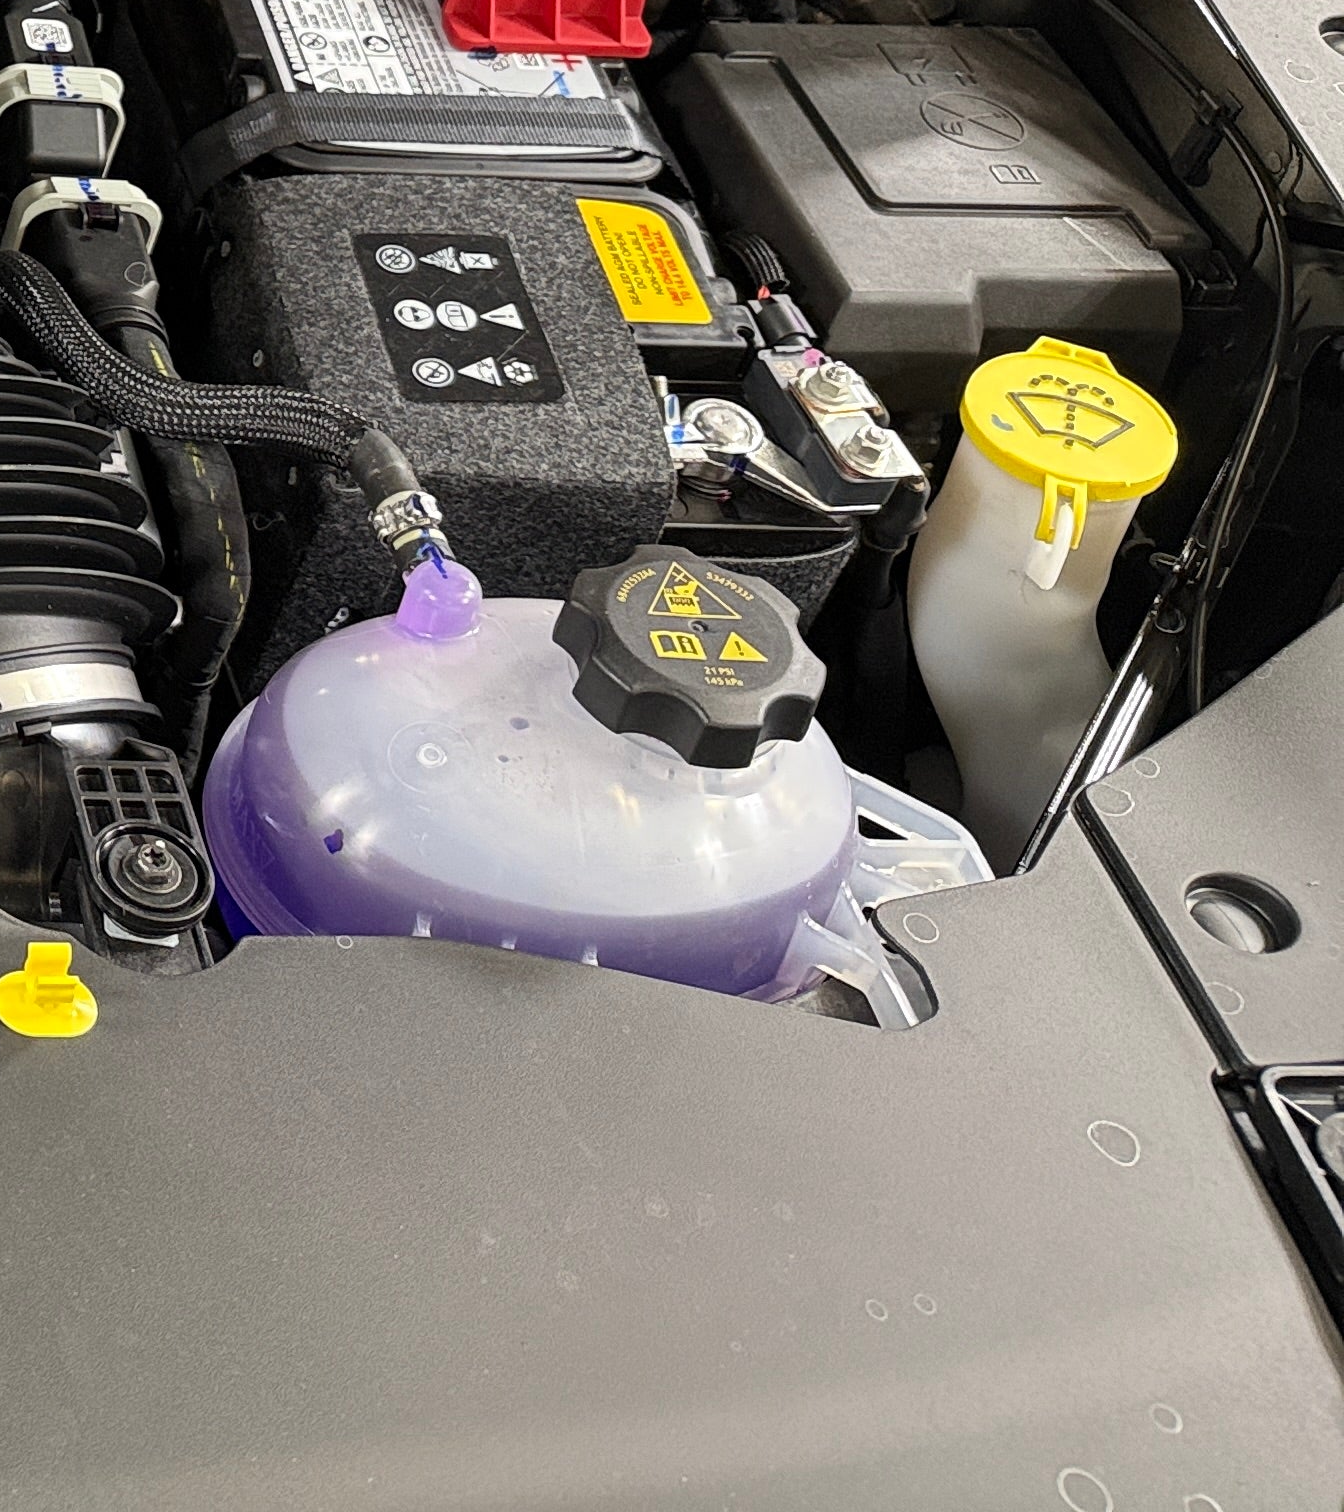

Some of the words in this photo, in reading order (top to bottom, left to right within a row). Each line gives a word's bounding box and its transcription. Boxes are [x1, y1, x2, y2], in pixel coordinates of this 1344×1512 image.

[593, 216, 617, 251] BATTERY
[625, 259, 640, 275] NOT
[626, 230, 664, 295] NON-SPILLABLE
[620, 272, 643, 305] SEALED
